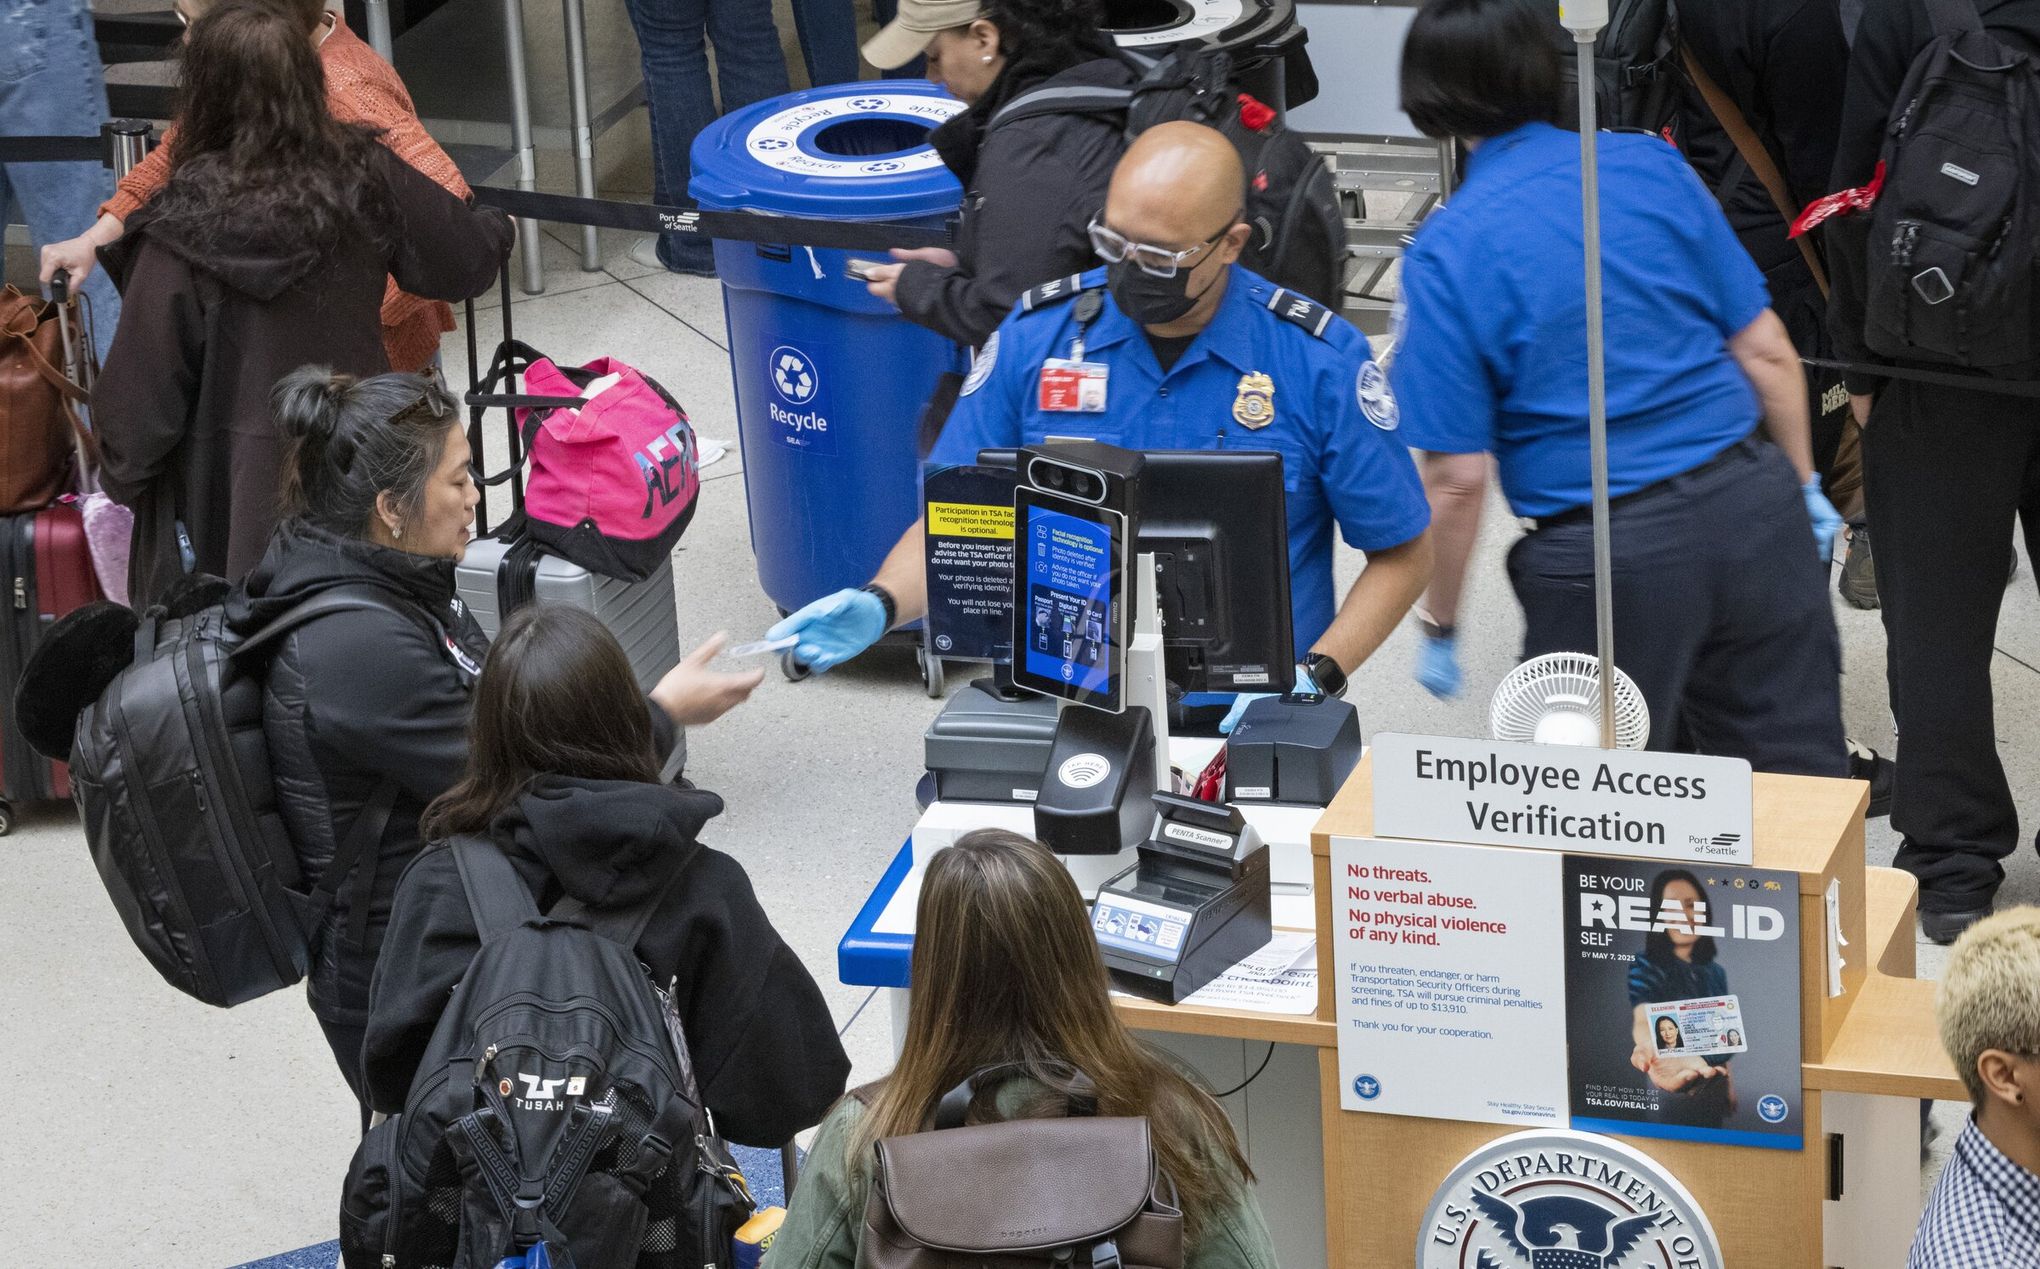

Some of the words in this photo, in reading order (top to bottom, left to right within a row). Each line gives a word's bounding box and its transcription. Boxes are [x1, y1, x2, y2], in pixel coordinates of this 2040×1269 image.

[781, 109, 832, 130] Recycle
[788, 156, 841, 168] Recycle
[660, 213, 675, 222] Port
[665, 222, 672, 230] of
[673, 222, 698, 232] Seattle
[770, 402, 827, 432] Recycle
[936, 506, 979, 516] Participation
[940, 517, 978, 525] recognition
[980, 518, 1014, 527] technolog
[1052, 528, 1066, 537] Facial
[1067, 532, 1094, 545] recognition
[1052, 536, 1078, 548] technology
[1083, 543, 1104, 555] optional.
[1052, 546, 1066, 554] Photo
[1067, 549, 1084, 560] deleted
[1085, 554, 1096, 563] after
[1052, 553, 1070, 564] identity
[1052, 563, 1068, 574] Advise
[1077, 568, 1092, 579] officer
[953, 583, 983, 591] verifying
[984, 584, 1011, 593] identity.
[1052, 577, 1066, 586] photo
[1077, 576, 1090, 585] want
[1090, 580, 1102, 588] your
[1034, 595, 1053, 605] Passport
[1050, 590, 1069, 601] Present
[1069, 595, 1080, 604] Your
[1080, 598, 1087, 606] ID
[1058, 602, 1072, 611] Digital
[1416, 750, 1580, 794] Employee
[1592, 763, 1706, 799] Access
[1466, 801, 1665, 845] Verification
[1172, 828, 1194, 838] PENTA
[1689, 835, 1708, 844] Port
[1705, 846, 1737, 856] Seattle
[1348, 863, 1369, 878] No
[1373, 865, 1432, 883] threats.
[1580, 874, 1597, 888] BE
[1600, 876, 1645, 892] YOUR
[1348, 886, 1370, 900] No
[1374, 890, 1423, 905] verbal
[1427, 892, 1477, 909] abuse.
[1349, 908, 1371, 922] No
[1374, 911, 1436, 928] physical
[1441, 916, 1506, 934] violence
[1580, 892, 1726, 937] REAL
[1732, 903, 1785, 941] ID
[1349, 926, 1365, 940] of
[1369, 929, 1398, 944] any
[1402, 930, 1440, 946] kind.
[1580, 931, 1613, 947] SELF
[1350, 962, 1356, 971] If
[1359, 964, 1376, 973] you
[1378, 965, 1417, 977] threaten,
[1420, 969, 1462, 981] endanger,
[1476, 972, 1500, 983] harm
[1350, 974, 1414, 987] Transportation
[1416, 979, 1453, 991] Security
[1455, 982, 1490, 994] Officers
[1492, 986, 1520, 997] during
[1351, 986, 1395, 998] screening,
[1397, 988, 1414, 998] TSA
[1417, 991, 1432, 1000] will
[1434, 993, 1464, 1003] pursue
[1466, 995, 1501, 1005] criminal
[1503, 999, 1543, 1009] penalties
[1352, 997, 1368, 1006] and
[1370, 997, 1392, 1008] fines
[1394, 1000, 1404, 1008] of
[1420, 1002, 1429, 1011] to
[1431, 1002, 1468, 1014] $13,910.
[1352, 1019, 1380, 1029] Thank
[1382, 1023, 1398, 1031] you
[1401, 1023, 1414, 1032] for
[1416, 1026, 1436, 1034] your
[1439, 1028, 1493, 1040] cooperation.
[1586, 1098, 1660, 1111] TSA.GOV/REAL-ID
[1502, 1109, 1556, 1118] tsa.gov/coronavirus
[1434, 1204, 1471, 1246] U.S.
[1475, 1152, 1682, 1232] DEPARTMENT
[1672, 1236, 1701, 1269] OF
